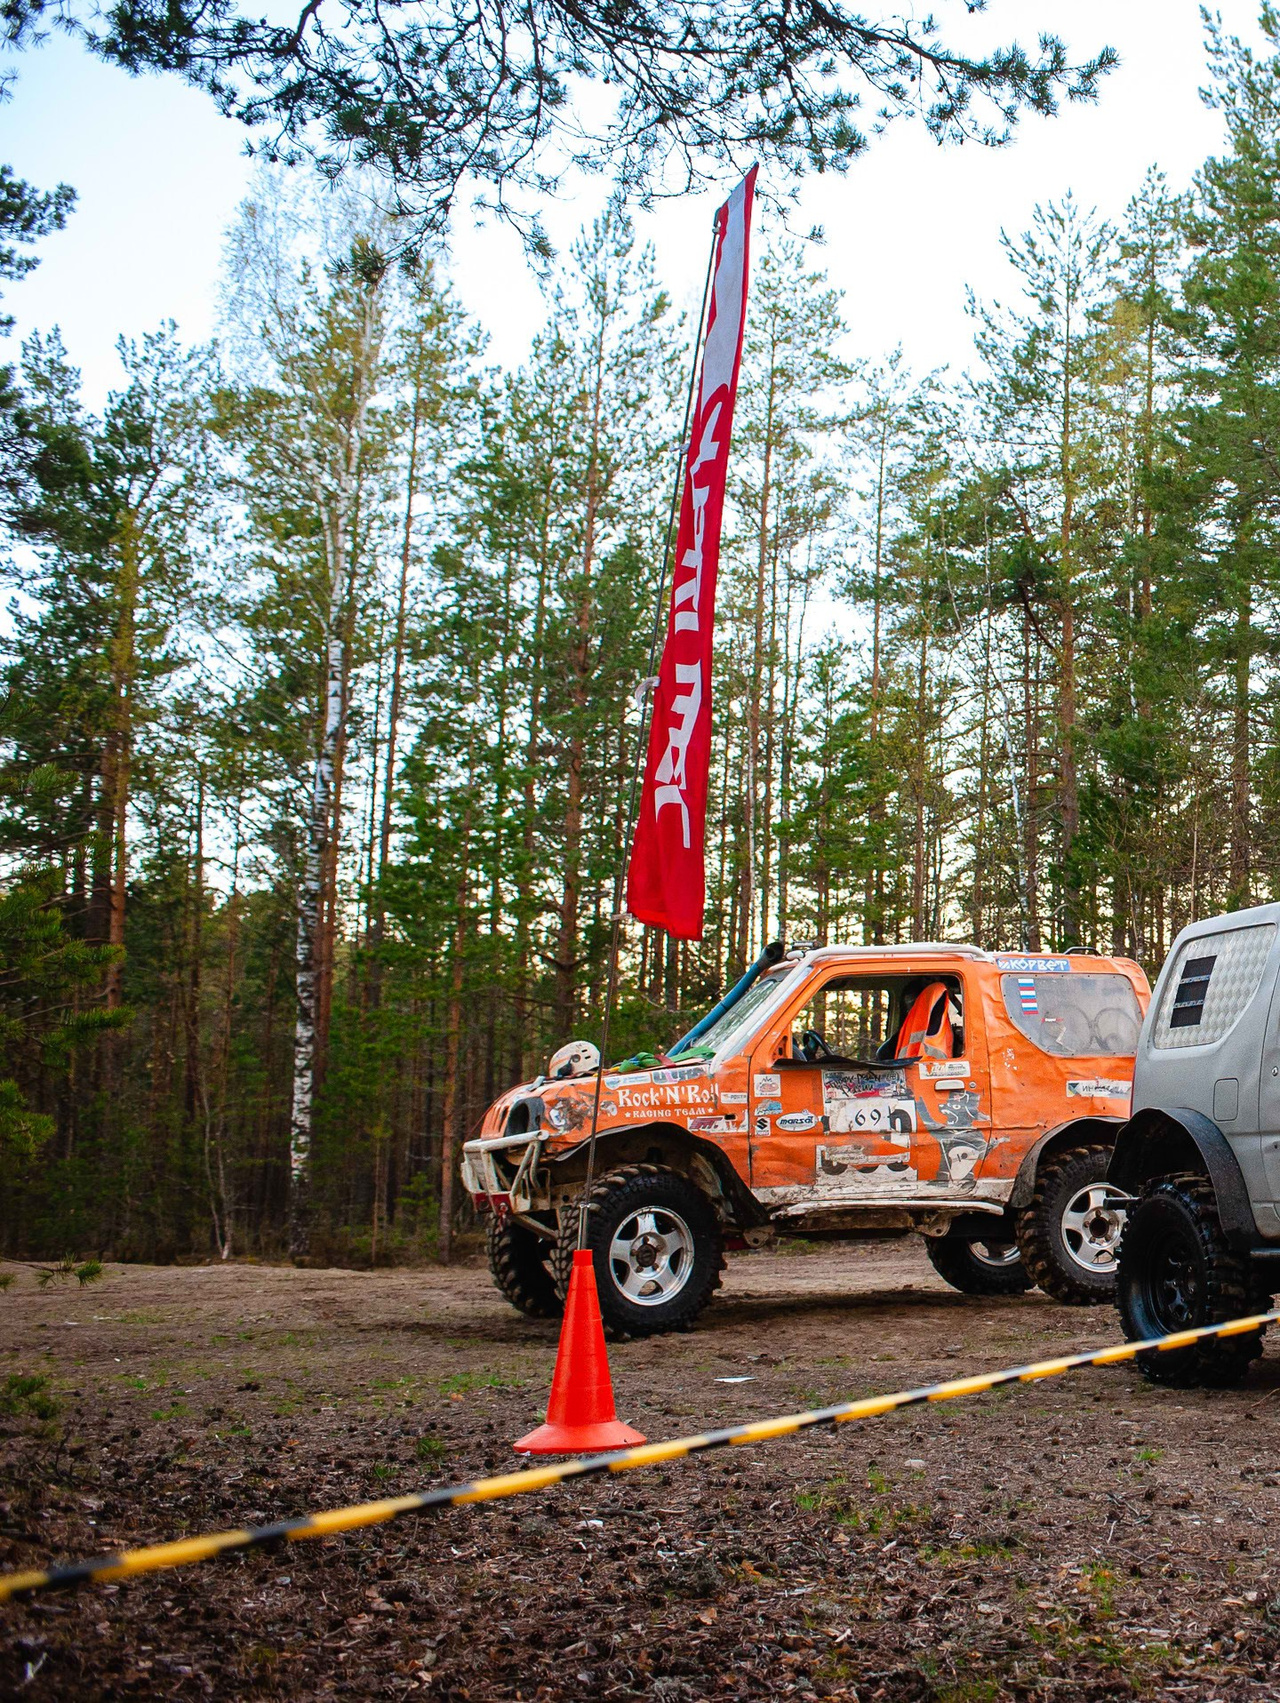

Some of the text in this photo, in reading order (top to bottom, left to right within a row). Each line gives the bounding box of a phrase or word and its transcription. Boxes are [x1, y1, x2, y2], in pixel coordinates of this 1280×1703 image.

[633, 1106, 706, 1118] RACING TEAM
[854, 1108, 882, 1127] 69
